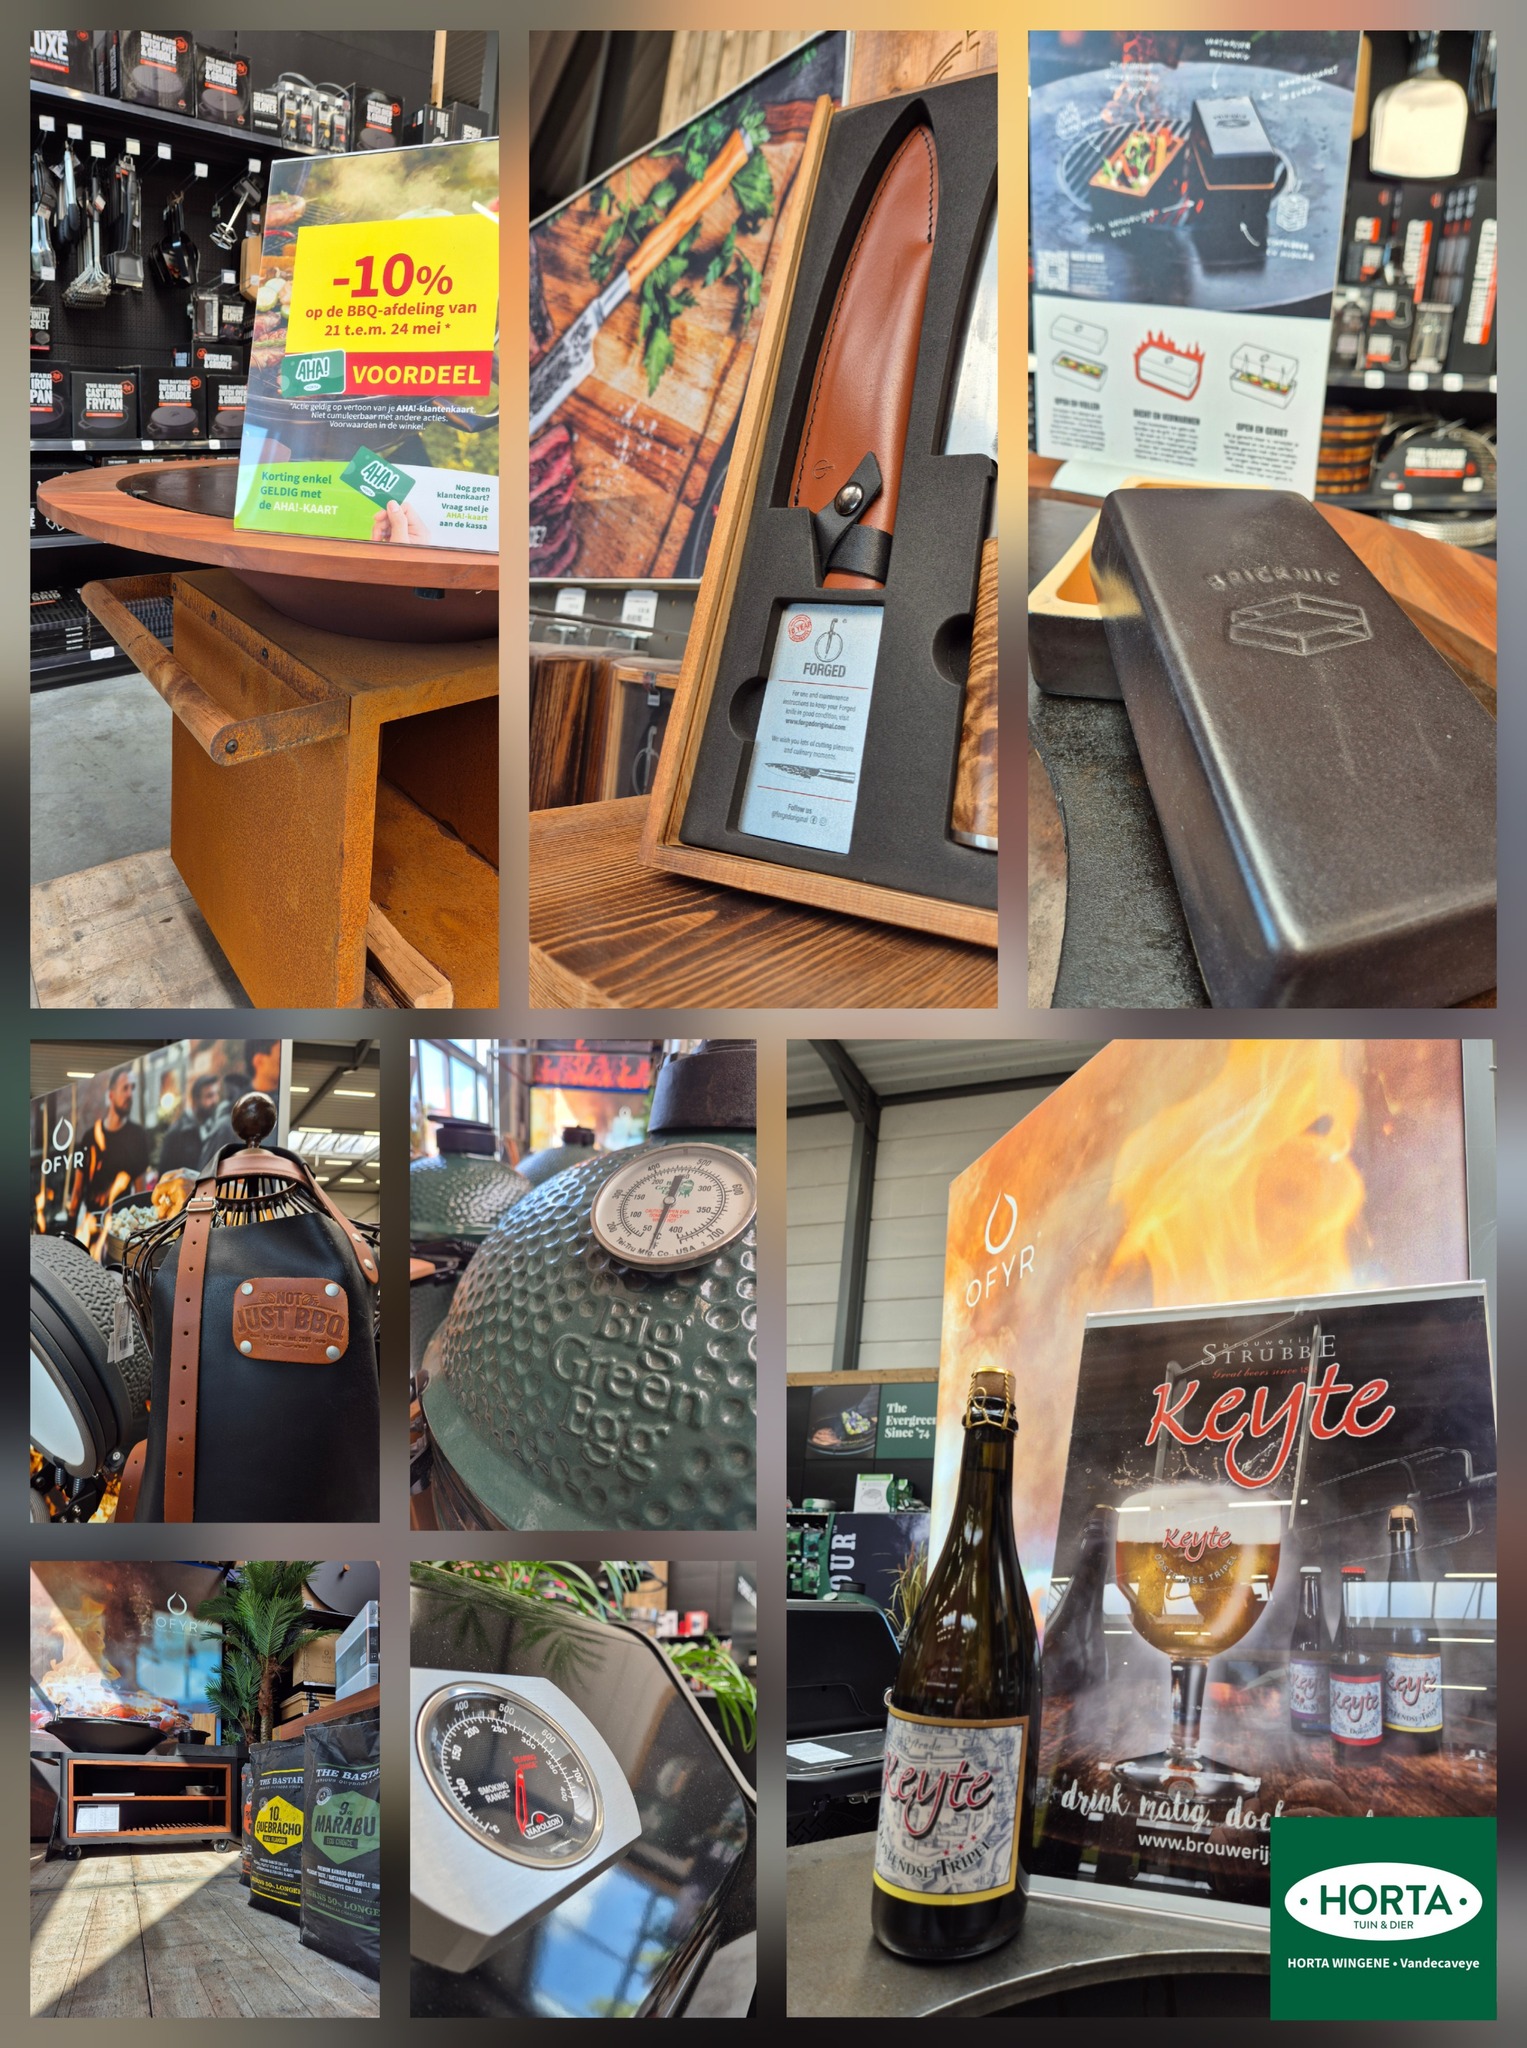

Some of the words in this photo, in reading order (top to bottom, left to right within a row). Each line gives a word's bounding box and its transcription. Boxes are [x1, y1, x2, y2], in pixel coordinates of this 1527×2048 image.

[30, 30, 69, 62] UXE
[333, 253, 453, 299] -10%
[305, 307, 323, 320] op
[327, 305, 343, 318] de
[347, 302, 444, 319] BBQ-afdeling
[449, 303, 477, 314] van
[324, 325, 340, 336] 21
[345, 324, 386, 336] t.e.m.
[391, 323, 409, 335] 24
[412, 321, 441, 334] mei
[296, 356, 330, 382] AHA!
[352, 365, 482, 385] VOORDEEL
[86, 398, 123, 410] FRYPAN
[311, 403, 331, 412] geldig
[343, 404, 372, 412] vertoon
[387, 404, 395, 413] je
[311, 411, 325, 419] Niet
[327, 412, 377, 420] cumuleerbaar
[378, 412, 393, 420] met
[395, 413, 422, 421] andere
[423, 414, 448, 422] acties.
[330, 420, 378, 429] Voorwaarden
[379, 421, 386, 429] in
[387, 421, 397, 429] de
[398, 422, 426, 430] winkel.
[262, 471, 300, 485] Korting
[302, 472, 332, 485] enkel
[361, 459, 399, 493] AHA!
[260, 486, 298, 498] GELDIG
[300, 487, 321, 499] met
[436, 491, 490, 501] klantenkaart?
[455, 484, 469, 494] Nog
[471, 485, 491, 495] geen
[259, 500, 271, 510] de
[273, 501, 338, 515] AHA!-KAART
[441, 503, 462, 514] Vraag
[464, 504, 481, 513] snel
[481, 505, 489, 514] je
[446, 511, 489, 521] AHA!-kaart
[439, 521, 454, 529] aan
[455, 520, 464, 529] de
[465, 521, 488, 530] kassa
[803, 663, 846, 678] FORGED
[41, 1150, 84, 1175] OFYR
[696, 1158, 712, 1167] 500
[633, 1193, 645, 1201] 150
[696, 1206, 712, 1214] 350
[643, 1224, 652, 1232] 50
[669, 1226, 683, 1234] 400
[706, 1228, 725, 1242] 700
[676, 1245, 697, 1256] USA
[966, 1244, 1035, 1308] OFYR
[276, 1292, 303, 1306] NOT
[237, 1306, 288, 1333] JUST
[295, 1307, 346, 1341] BBQ
[1201, 1335, 1336, 1366] STRUBBE
[552, 1333, 710, 1427] Green
[887, 1402, 908, 1414] The
[885, 1427, 914, 1439] Since
[1145, 1362, 1396, 1490] Keyte
[1162, 1525, 1232, 1562] Keyte
[1154, 1553, 1205, 1584] OOSTEDSE
[1208, 1555, 1238, 1581] TRIPEL
[155, 1616, 198, 1633] OFYR
[455, 1700, 469, 1711] 400
[498, 1703, 515, 1716] 500
[464, 1725, 480, 1738] 200
[541, 1729, 556, 1744] 600
[520, 1736, 536, 1750] 300
[452, 1744, 462, 1761] 150
[316, 1768, 339, 1778] THE
[572, 1767, 584, 1783] 700
[456, 1778, 471, 1797] 100
[477, 1781, 509, 1796] SMOKING
[883, 1751, 995, 1840] Keyte
[339, 1801, 350, 1816] 9
[1061, 1779, 1130, 1817] drink
[1139, 1791, 1210, 1831] matig,
[269, 1806, 280, 1821] 10
[256, 1821, 301, 1837] QUEBRACHO
[315, 1815, 376, 1837] MARABU
[526, 1817, 560, 1836] NAPOLEON
[1138, 1832, 1270, 1866] www.brouwerij
